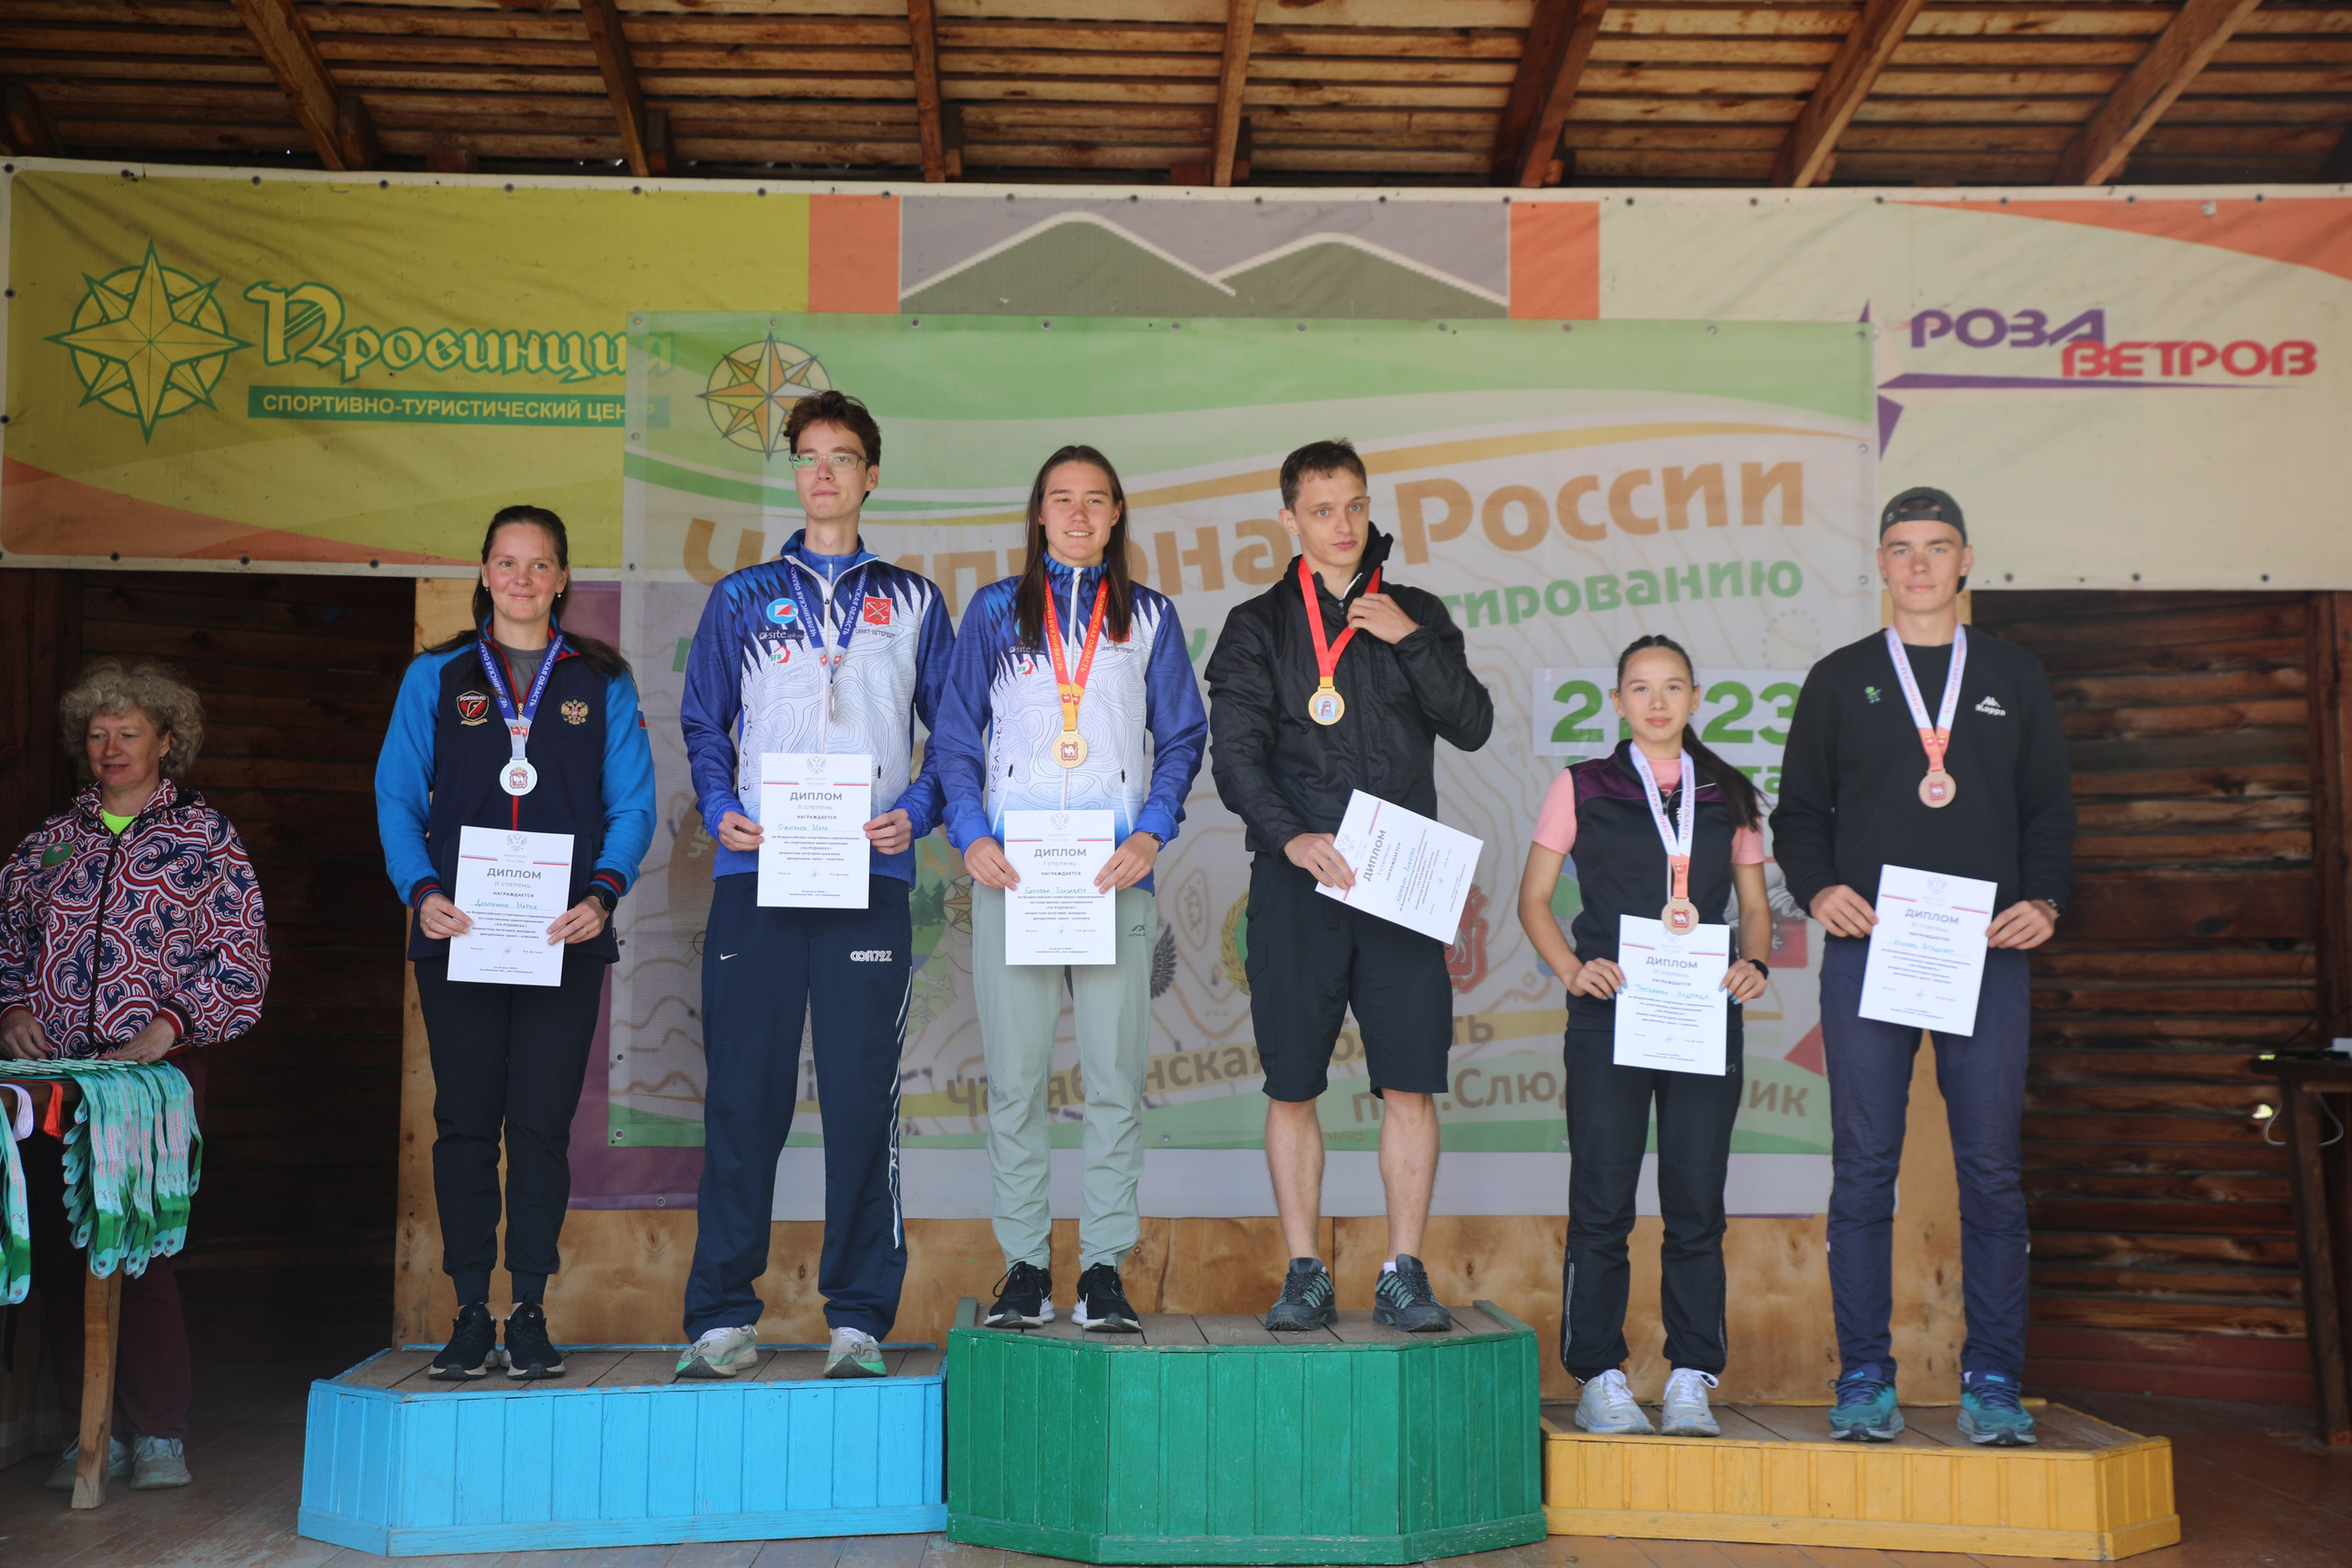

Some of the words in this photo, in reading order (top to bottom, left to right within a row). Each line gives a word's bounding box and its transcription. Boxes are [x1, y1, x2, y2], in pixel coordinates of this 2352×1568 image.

[1911, 309, 2106, 348] РОЗА
[2061, 339, 2318, 378] ВЕТРОВ
[262, 394, 582, 420] СПОРТИВНО-ТУРИСТИЧЕСКИЙ
[1394, 461, 1804, 566] России
[797, 591, 817, 637] ЧЕЛЯБИНСКАЯ
[843, 605, 857, 635] ОБЛАСТЬ
[1047, 619, 1063, 671] ЧЕЛЯБИНСКАЯ
[1080, 639, 1094, 672] ОБЛАСТЬ
[530, 676, 545, 707] ОБЛАСТЬ
[1550, 680, 1804, 746] 223
[1975, 704, 2006, 716] Kappa
[790, 792, 842, 801] ДИПЛОМ
[1034, 849, 1086, 858] ДИПЛОМ
[1363, 829, 1387, 882] ДИПЛОМ
[1379, 844, 1392, 872] степень
[1386, 843, 1401, 881] НАГРАЖДАЕТСЯ
[487, 868, 541, 879] ДИПЛОМ
[1905, 908, 1959, 924] ДИПЛОМ
[1646, 956, 1698, 969] ДИПЛОМ
[1652, 978, 1691, 986] НАГРАЖДАЕТСЯ
